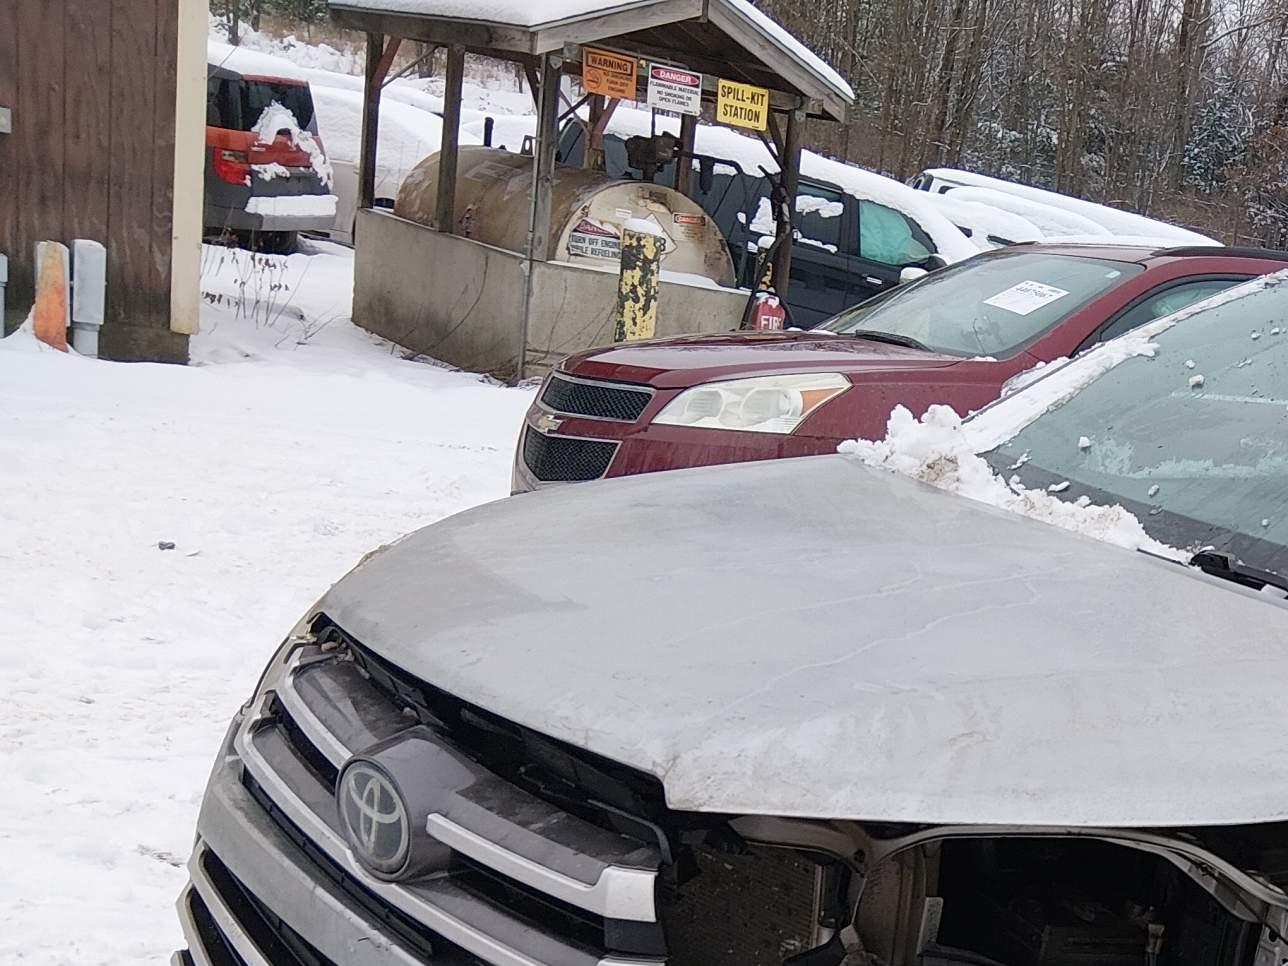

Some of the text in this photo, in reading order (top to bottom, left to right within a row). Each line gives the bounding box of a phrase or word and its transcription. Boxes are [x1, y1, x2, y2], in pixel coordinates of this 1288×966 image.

[590, 55, 628, 72] WARNING
[660, 70, 691, 85] DANGER
[721, 84, 766, 106] SPILL-KIT
[722, 103, 761, 124] STATION
[588, 237, 599, 246] OFF
